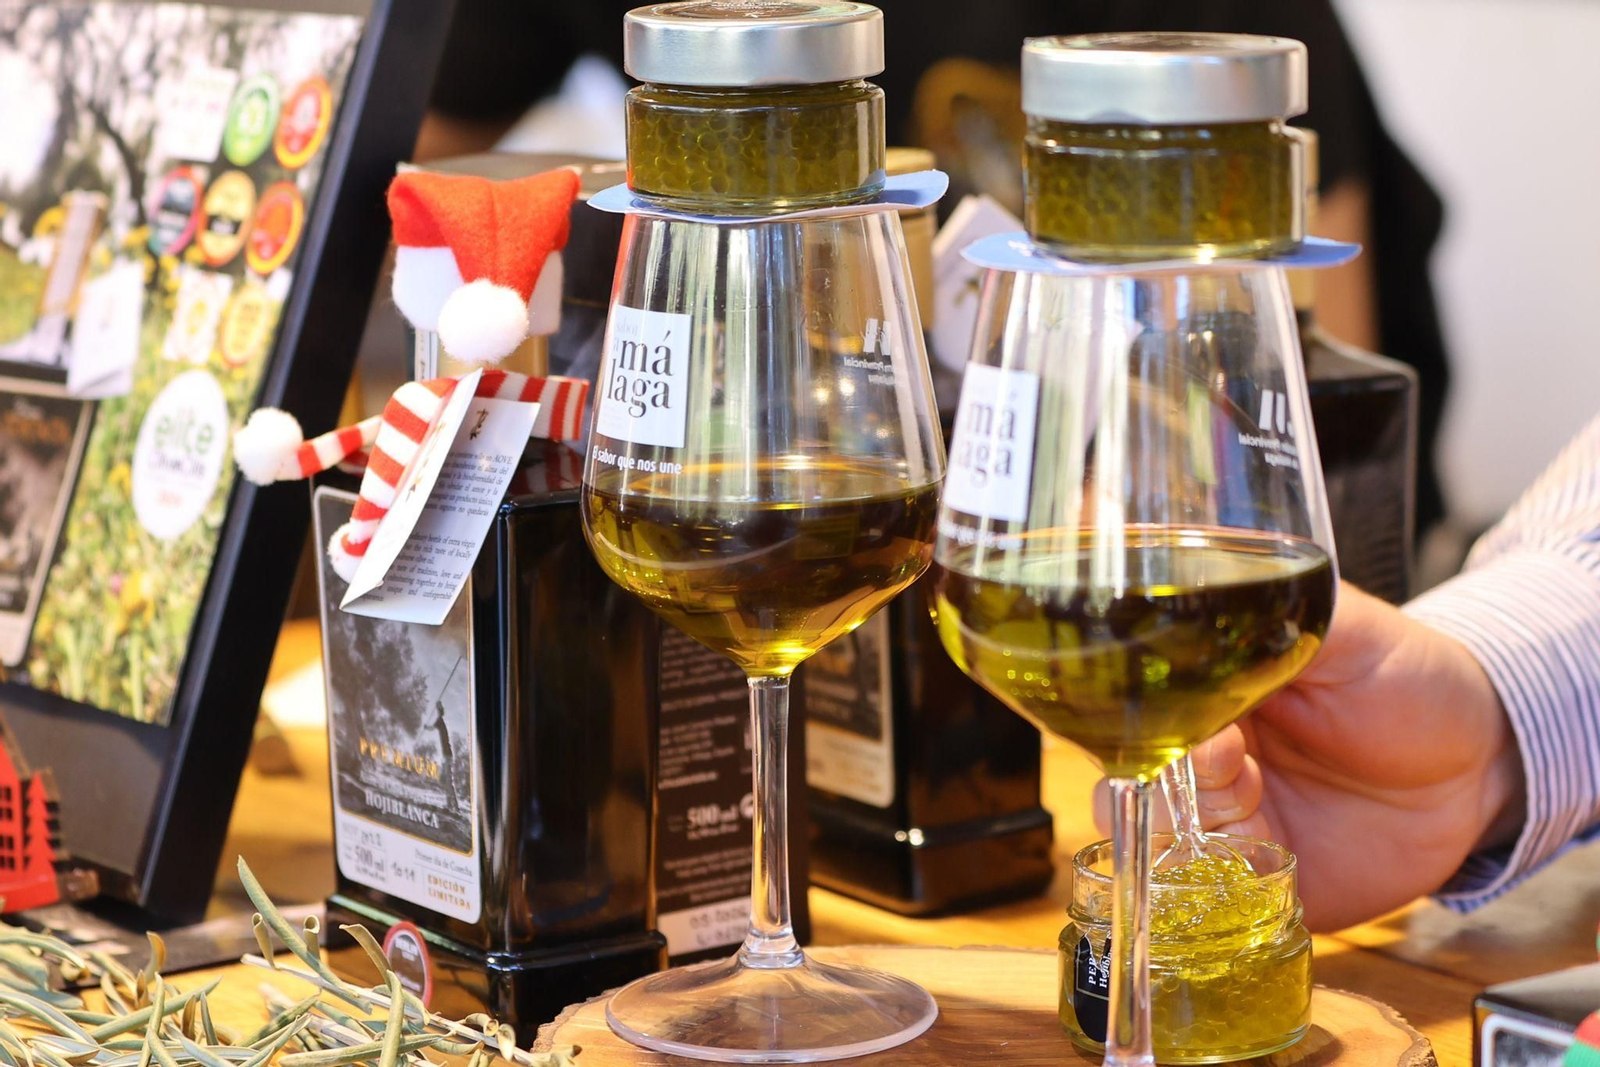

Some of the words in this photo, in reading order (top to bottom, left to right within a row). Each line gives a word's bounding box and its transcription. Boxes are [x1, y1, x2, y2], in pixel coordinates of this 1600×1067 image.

[619, 329, 675, 377] má
[607, 359, 673, 419] laga
[597, 447, 617, 466] sabor
[617, 455, 635, 471] que
[636, 458, 657, 473] nos
[658, 462, 683, 475] une
[958, 441, 1013, 488] aga
[359, 736, 438, 780] PREMIUM
[364, 789, 439, 829] HOJIBLANCA
